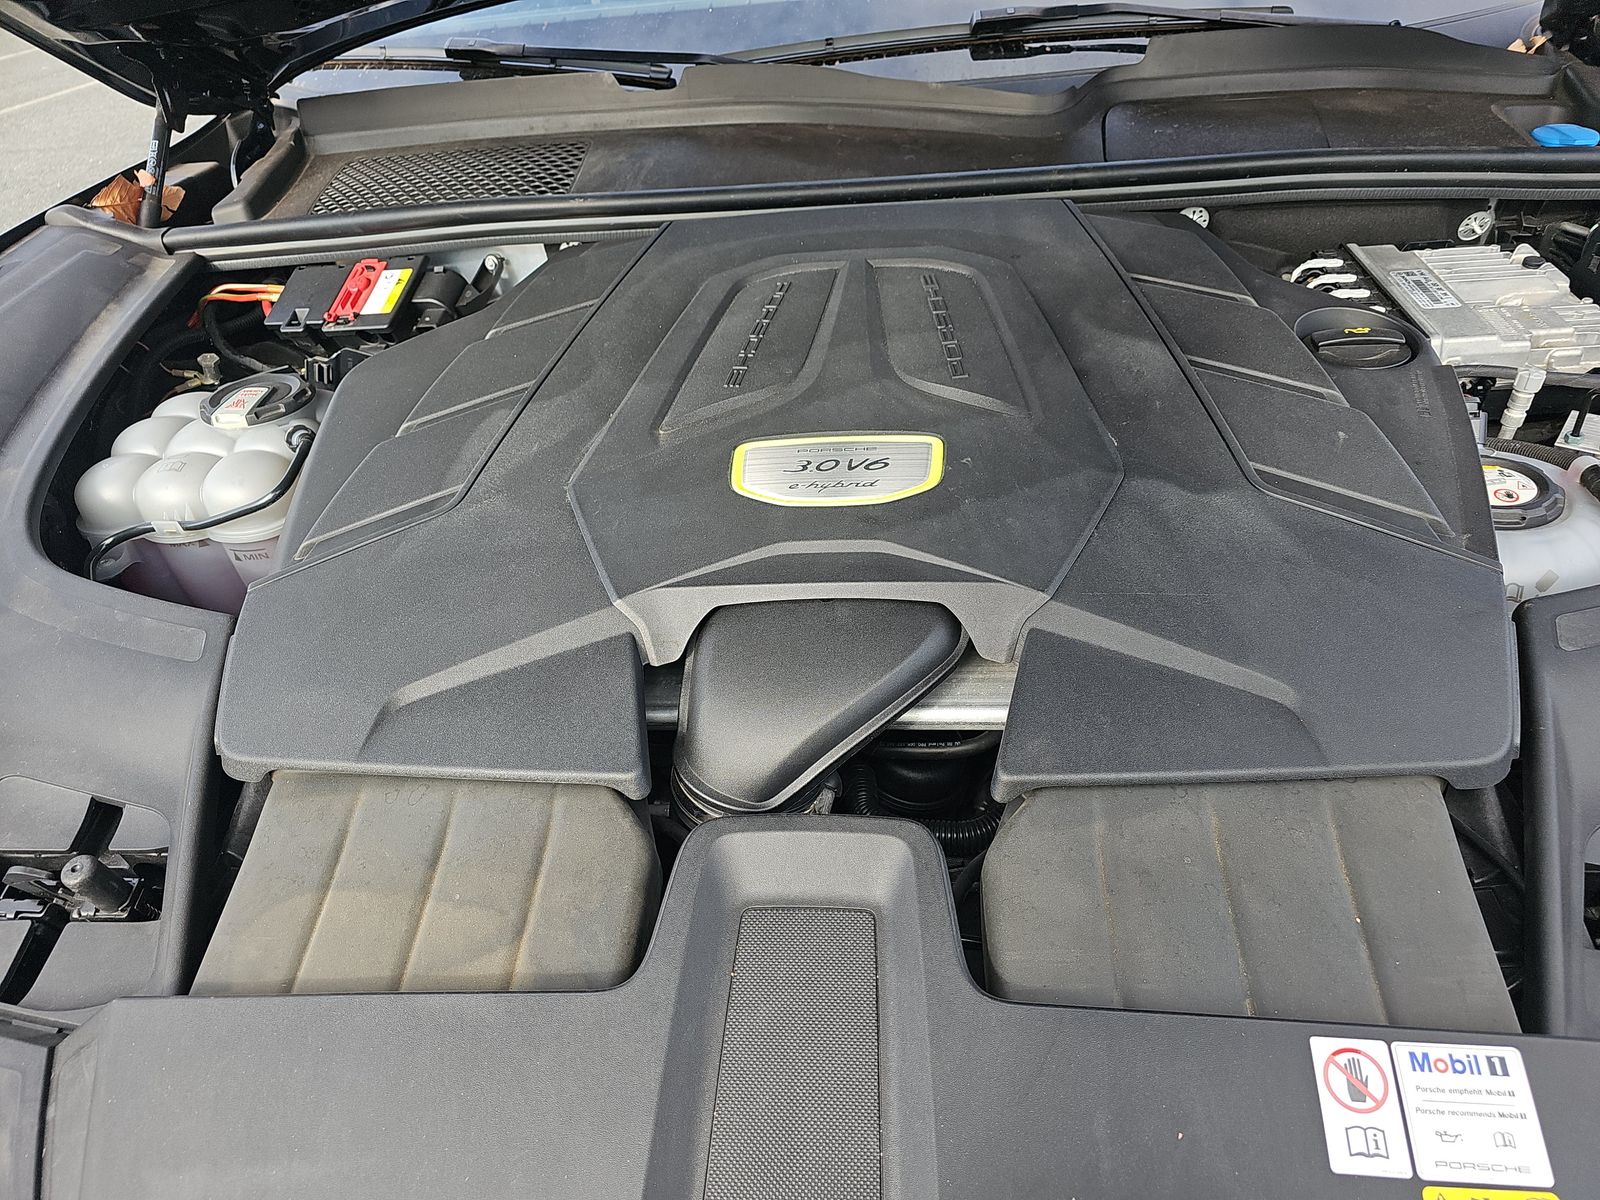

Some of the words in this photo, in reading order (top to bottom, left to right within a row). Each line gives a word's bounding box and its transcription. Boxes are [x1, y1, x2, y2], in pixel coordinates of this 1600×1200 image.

[921, 274, 969, 379] PORSCHE
[723, 281, 792, 387] PORSCHE
[797, 446, 878, 454] PORSCHE
[782, 459, 841, 473] 3.0
[847, 457, 890, 471] V6
[788, 479, 881, 494] e-hybrid
[243, 552, 270, 561] MIN
[1408, 1051, 1482, 1075] Mobil
[1487, 1056, 1508, 1077] 1
[1415, 1085, 1446, 1094] Porsche
[1485, 1089, 1507, 1097] Mobil
[1415, 1107, 1446, 1116] Porsche
[1448, 1110, 1497, 1118] recommends
[1498, 1111, 1519, 1119] Mobil
[1434, 1160, 1532, 1174] PORSCHE
